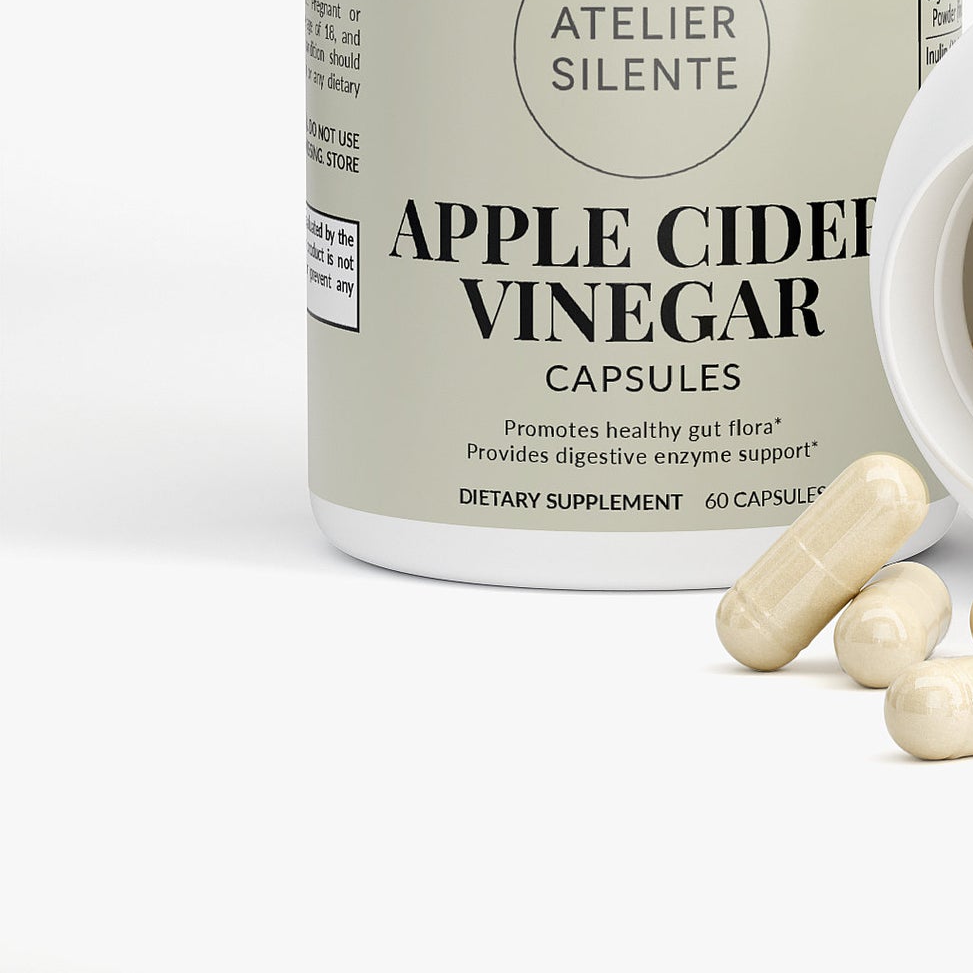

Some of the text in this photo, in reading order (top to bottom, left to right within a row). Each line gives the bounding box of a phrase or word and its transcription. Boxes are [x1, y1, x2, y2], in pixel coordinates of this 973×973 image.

[349, 9, 361, 22] or
[551, 6, 735, 40] ATELIER
[932, 3, 957, 28] Powder
[325, 23, 337, 44] 18,
[342, 29, 361, 47] and
[329, 48, 360, 70] should
[313, 71, 325, 90] any
[327, 72, 361, 99] dietary
[551, 57, 738, 91] SILENTE
[318, 123, 336, 144] NOT
[338, 130, 360, 149] USE
[326, 151, 360, 173] STORE
[325, 223, 336, 246] by
[338, 228, 354, 247] the
[388, 199, 632, 268] APPLE
[327, 248, 334, 266] is
[337, 255, 354, 271] not
[336, 279, 354, 298] any
[459, 277, 826, 343] VINEGAR
[545, 363, 742, 393] CAPSULES
[504, 419, 599, 439] Promotes
[606, 421, 682, 443] healthy
[688, 421, 722, 442] gut
[467, 443, 549, 464] Provides
[555, 446, 647, 468] digestive
[654, 450, 732, 468] enzyme
[459, 488, 684, 511] DIETARY SUPPLEMENT
[704, 492, 729, 510] 60
